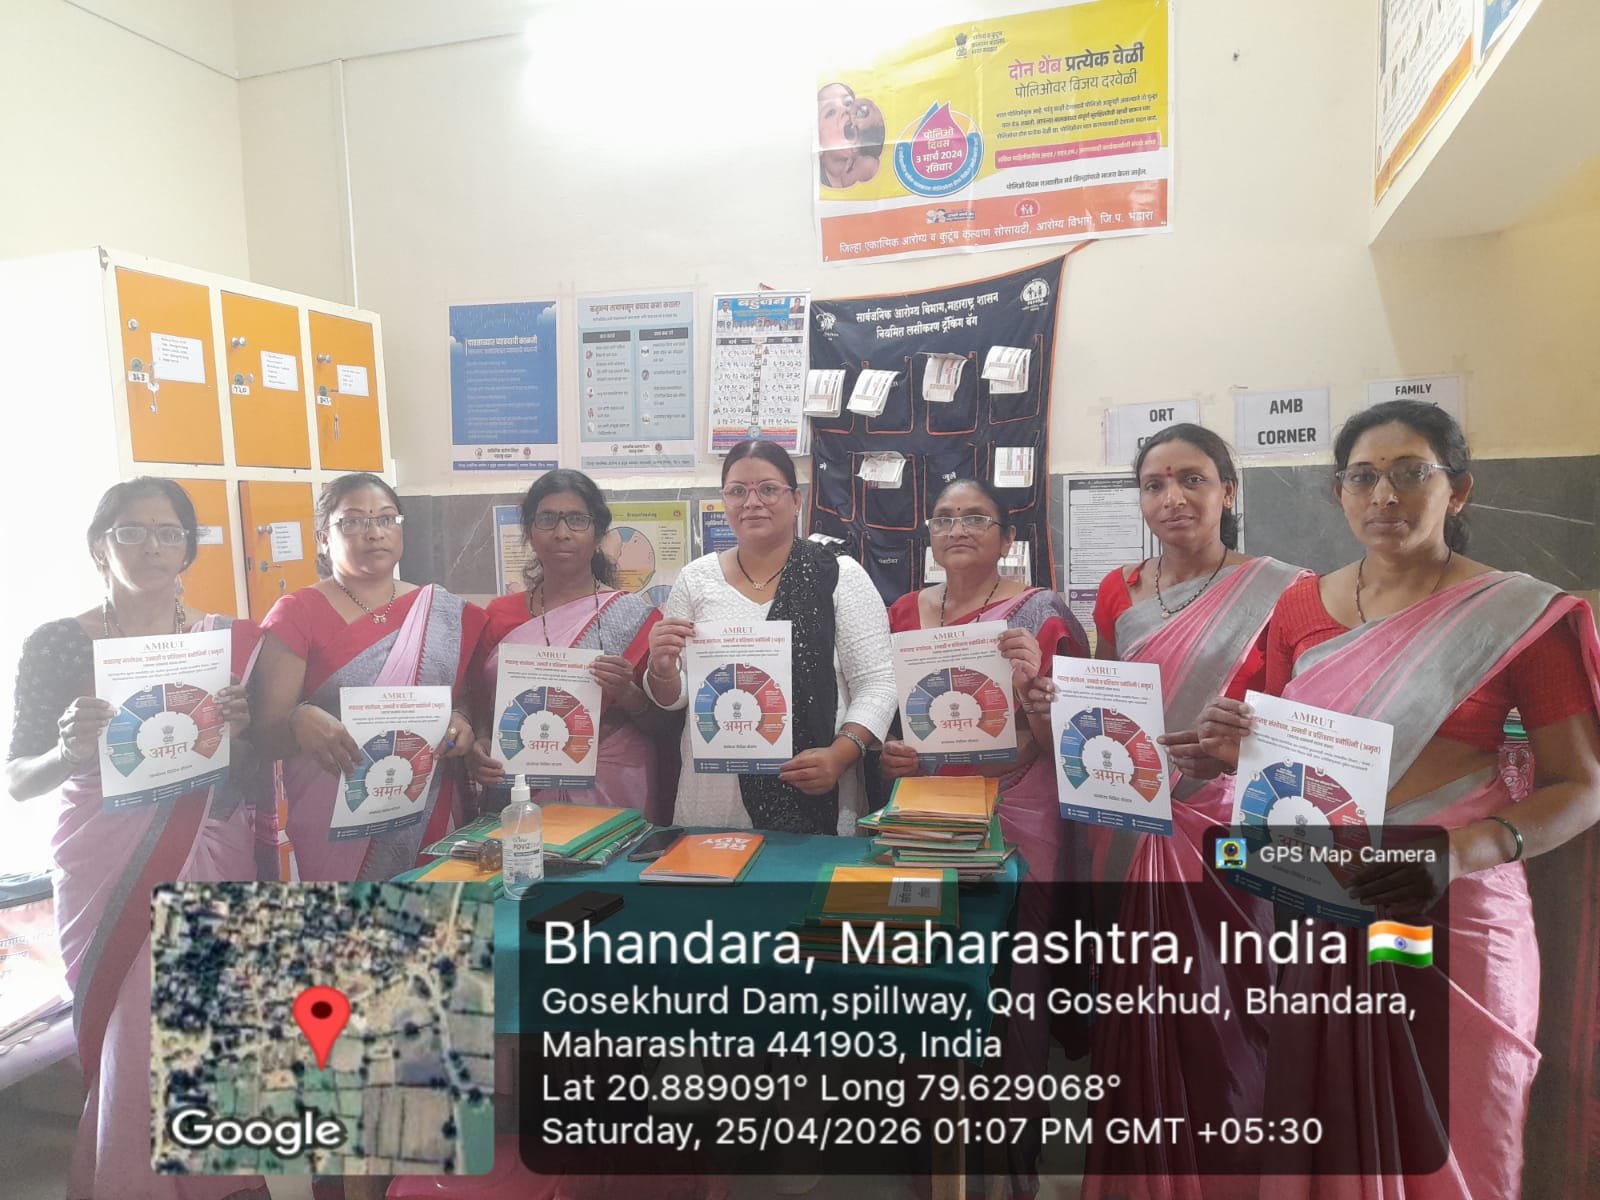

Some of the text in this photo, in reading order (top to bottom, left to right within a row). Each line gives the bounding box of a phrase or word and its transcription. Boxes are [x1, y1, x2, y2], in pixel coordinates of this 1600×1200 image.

[1008, 42, 1144, 80] दोन थेंब प्रत्येक वेळी
[1015, 68, 1137, 98] पोलिओवर विजय दरवेळी
[924, 127, 954, 139] पोलिओ
[928, 140, 950, 150] दिवस
[922, 151, 939, 161] मार्च
[941, 150, 962, 160] 2024
[926, 162, 952, 173] रविवार
[840, 242, 861, 254] जिल्हा
[864, 237, 898, 252] एकात्मिक
[902, 232, 927, 246] आरोग्य
[930, 232, 936, 241] व
[962, 227, 990, 242] कल्याण
[1037, 217, 1064, 232] आरोग्य
[856, 308, 892, 322] सार्वजनिक
[894, 304, 920, 318] आरोग्य
[977, 292, 999, 305] शासन
[876, 324, 904, 339] नियमित
[906, 320, 940, 336] लसीकरण
[1395, 384, 1432, 396] FAMILY
[1270, 398, 1303, 415] AMB
[1149, 407, 1174, 422] ORT
[1258, 427, 1316, 446] CORNER
[932, 631, 966, 640] AMRUT
[144, 640, 184, 651] AMRUT
[1085, 666, 1118, 675] AMRUT
[940, 718, 973, 731] अमृत
[1291, 712, 1336, 728] AMRUT
[722, 721, 752, 735] अमृत
[149, 742, 188, 759] अमृत
[528, 740, 559, 754] अमृत
[1092, 768, 1126, 786] अमृत
[372, 785, 404, 799] अमृत
